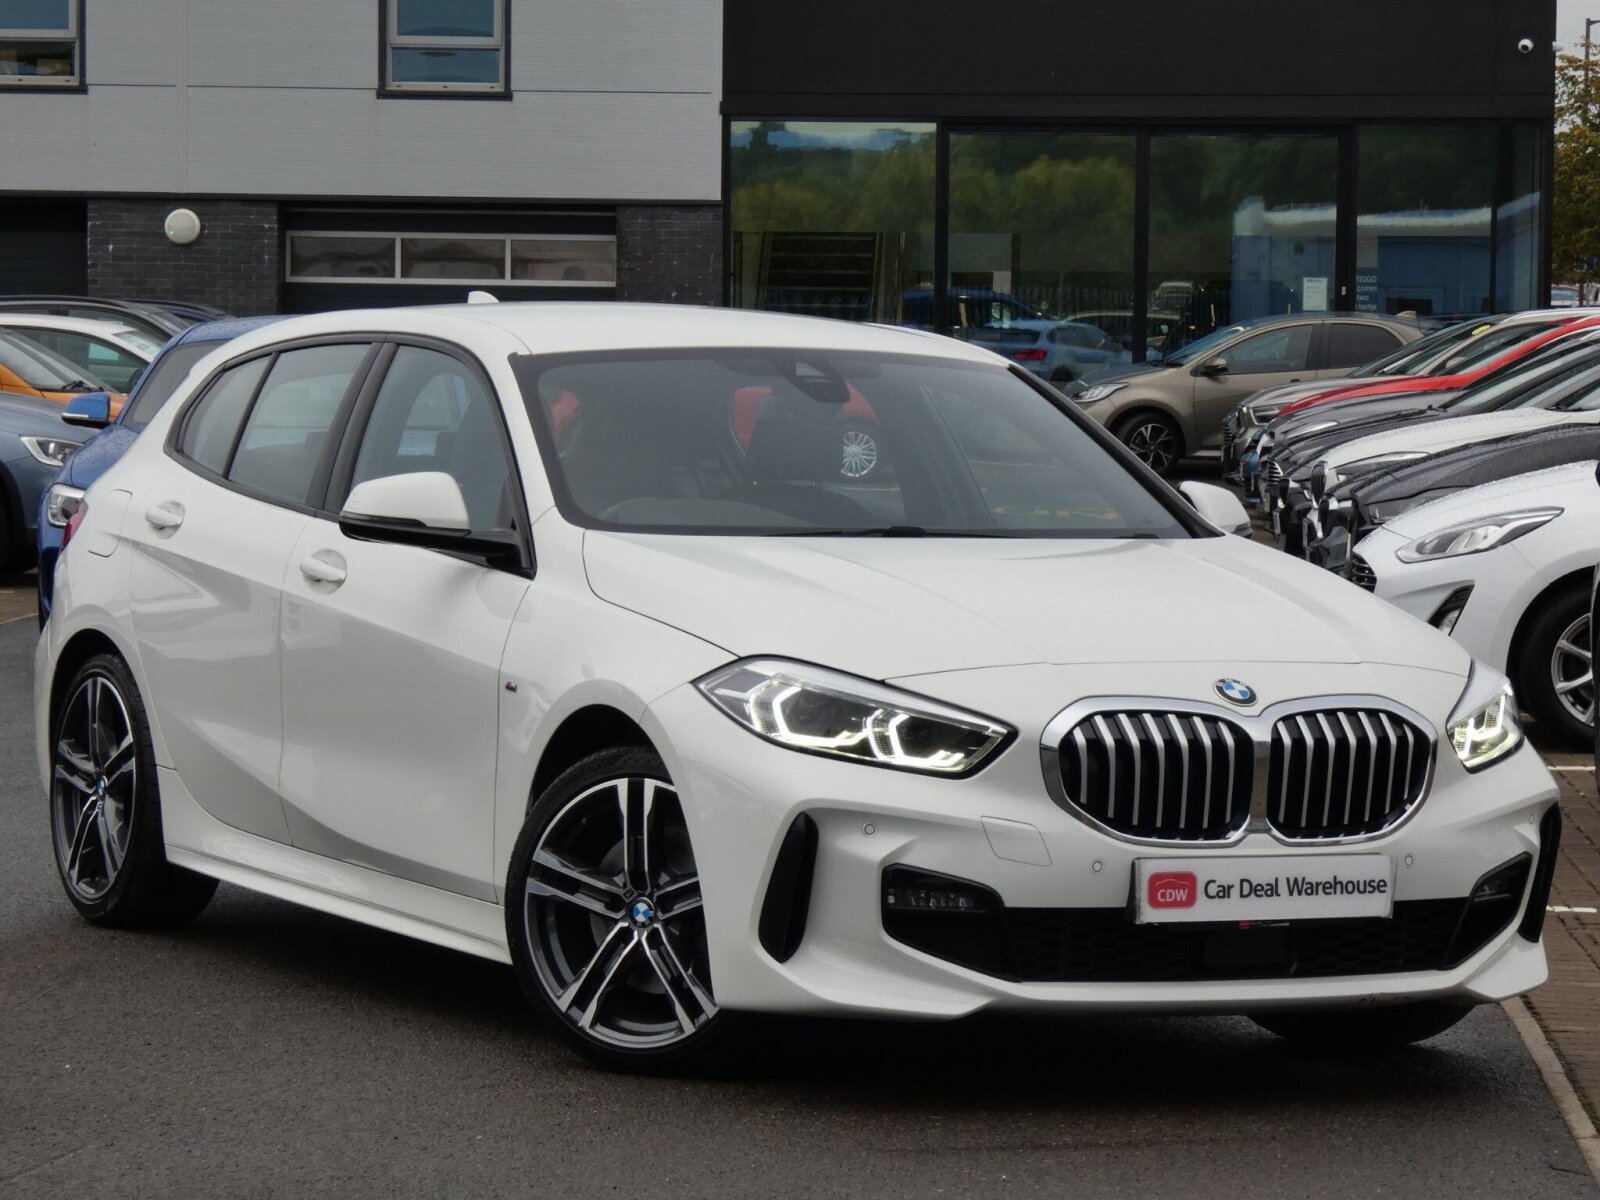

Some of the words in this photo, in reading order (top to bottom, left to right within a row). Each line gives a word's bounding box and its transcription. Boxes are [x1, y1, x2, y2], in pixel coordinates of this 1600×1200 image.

[1157, 889, 1188, 902] CDW
[1204, 879, 1234, 899] Car
[1239, 877, 1280, 898] Deal
[1286, 875, 1387, 897] Warehouse
